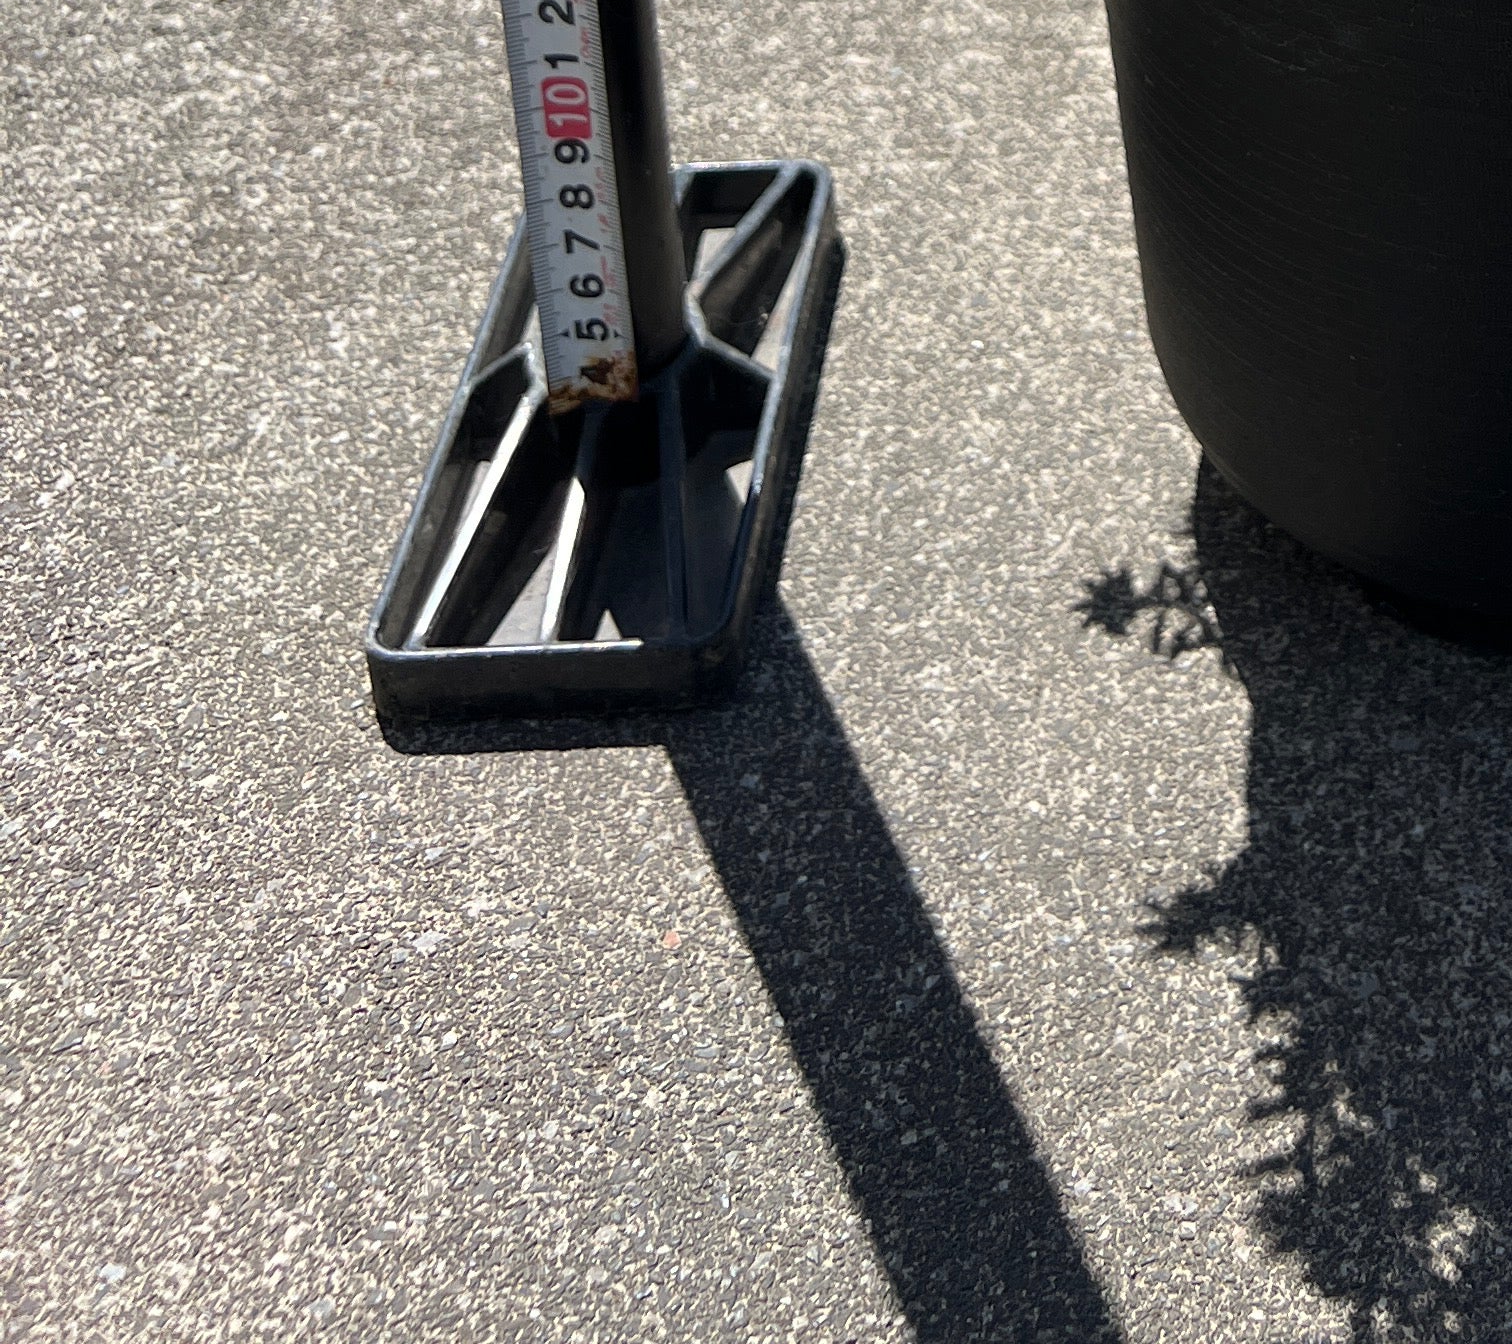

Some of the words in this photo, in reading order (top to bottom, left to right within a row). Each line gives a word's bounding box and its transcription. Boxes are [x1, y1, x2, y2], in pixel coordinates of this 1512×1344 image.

[538, 0, 575, 25] 2
[544, 54, 579, 69] 1
[545, 82, 588, 127] 10
[555, 139, 590, 164] 9
[559, 185, 594, 210] 8
[564, 230, 599, 254] 7
[570, 274, 604, 298] 6
[575, 319, 609, 341] 5
